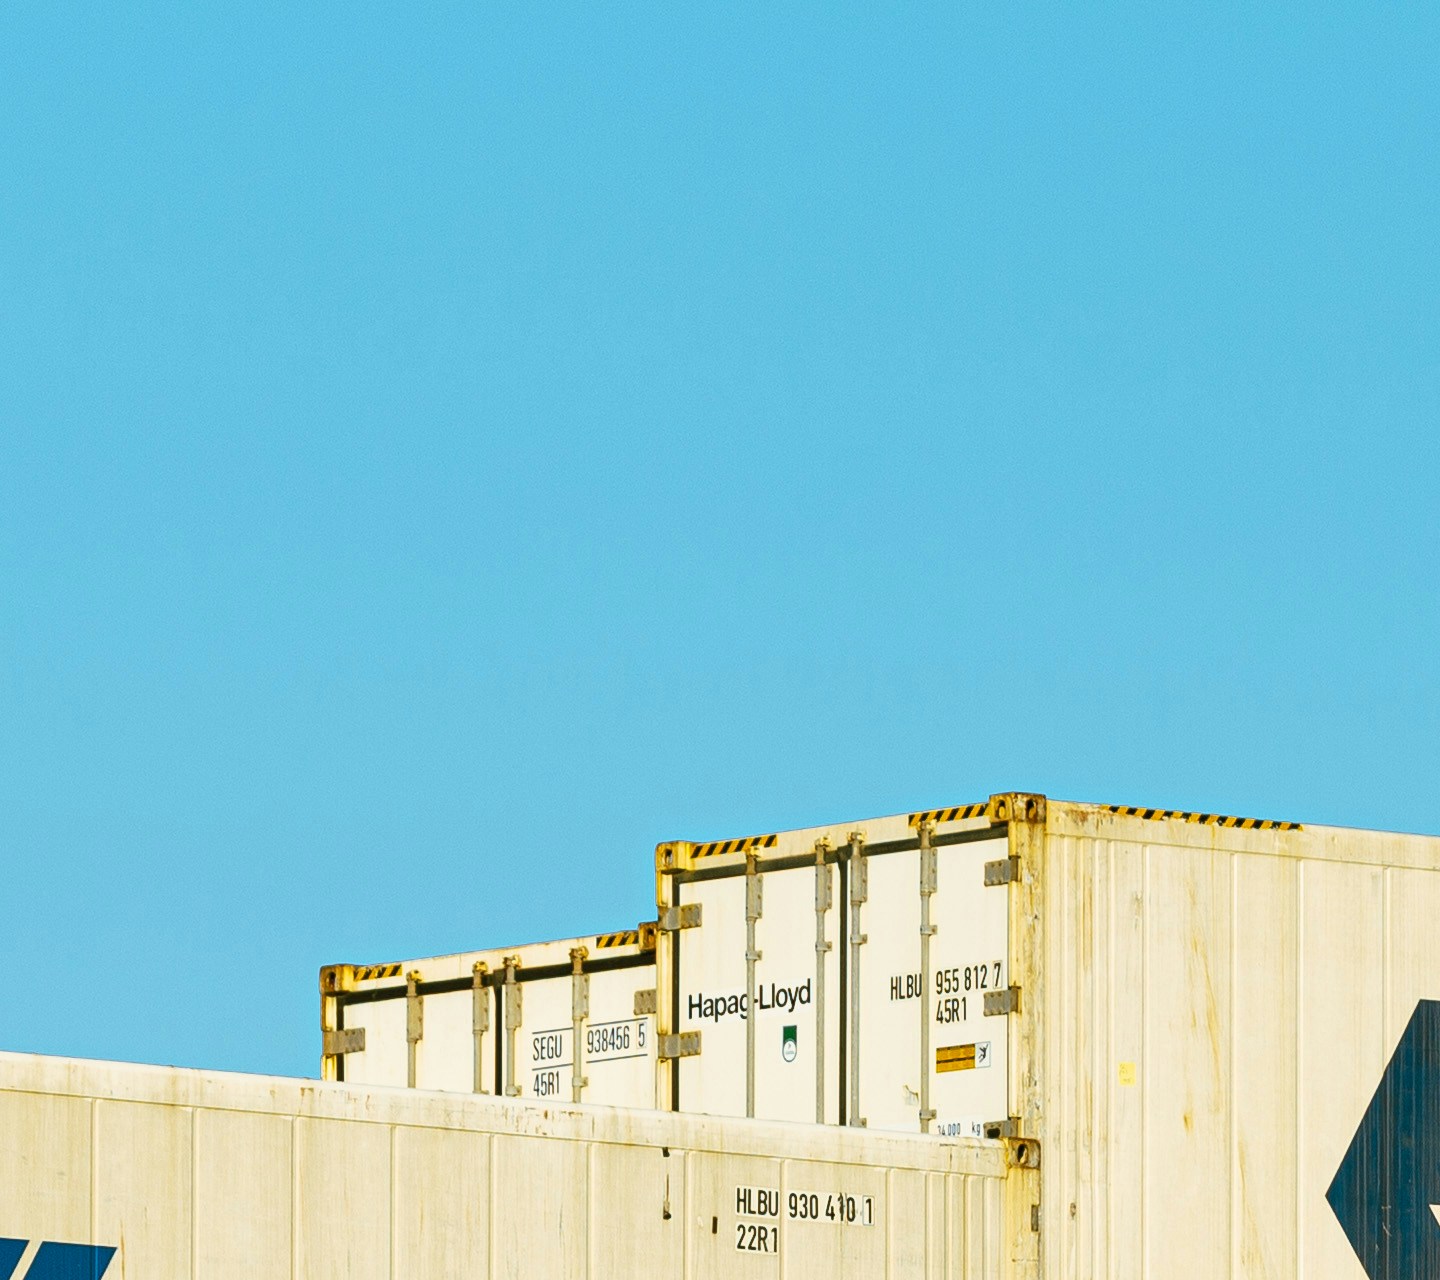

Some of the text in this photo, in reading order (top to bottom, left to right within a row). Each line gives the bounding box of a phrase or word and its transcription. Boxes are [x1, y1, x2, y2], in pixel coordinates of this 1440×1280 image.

[890, 961, 1002, 1003] HLBU 955 812 7
[688, 979, 812, 1024] Hapag-Lloyd
[935, 996, 968, 1025] 45R1
[532, 1020, 646, 1062] SEGU 938456 5
[533, 1070, 560, 1097] 45R1
[737, 1187, 873, 1224] HLBU 930 410 1
[736, 1224, 778, 1253] 22R1
